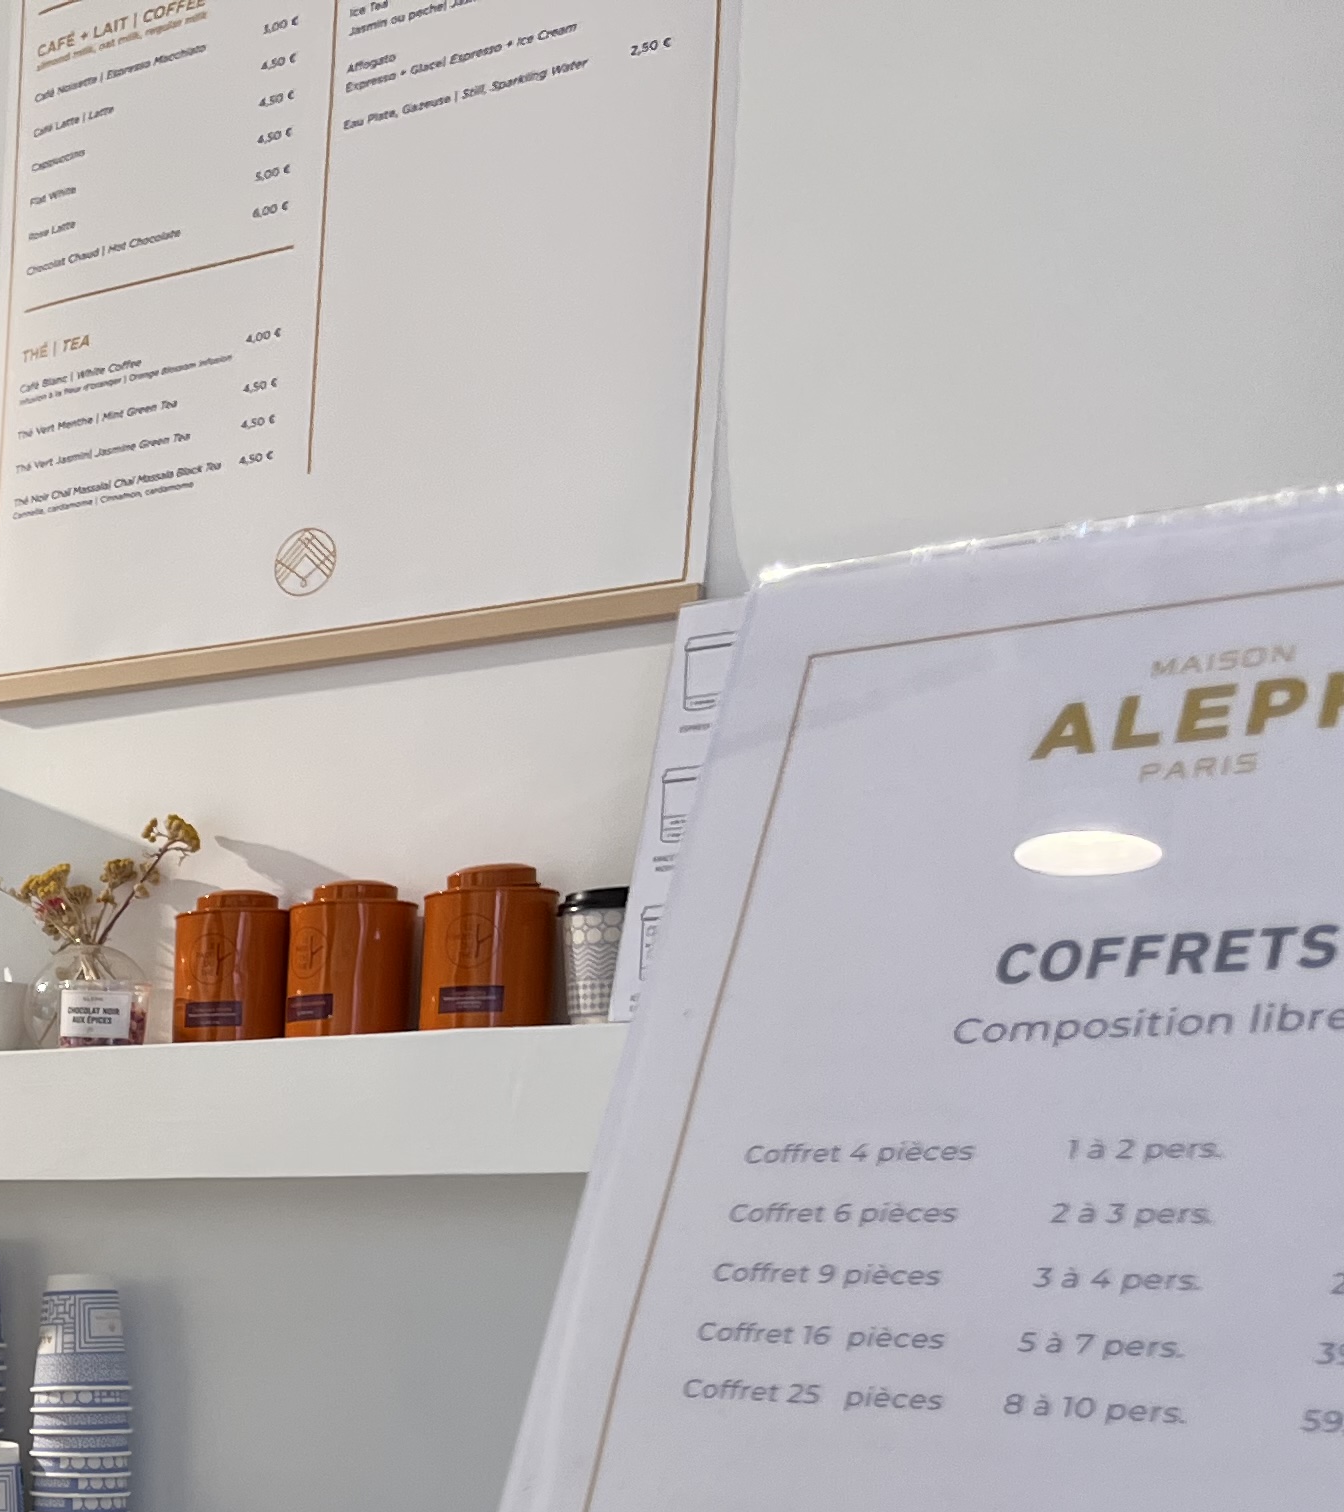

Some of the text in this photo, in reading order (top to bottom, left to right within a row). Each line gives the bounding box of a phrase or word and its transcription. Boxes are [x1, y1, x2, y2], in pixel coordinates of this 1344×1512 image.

[36, 30, 76, 57] CAFÉ
[92, 19, 129, 39] LAIT
[630, 39, 659, 57] 2,50
[23, 344, 49, 363] THÉ
[62, 335, 91, 352] TEA
[127, 404, 158, 418] Green
[1150, 644, 1297, 678] MAISON
[1138, 752, 1259, 784] PARIS
[994, 923, 1340, 985] COFFRETS
[952, 1002, 1344, 1047] Composition libre
[743, 1137, 1226, 1168] Coffret 4 pièces 1 à 2 pers.
[681, 1377, 1188, 1426] Coffret 25 pièces 8 à 10 pers.
